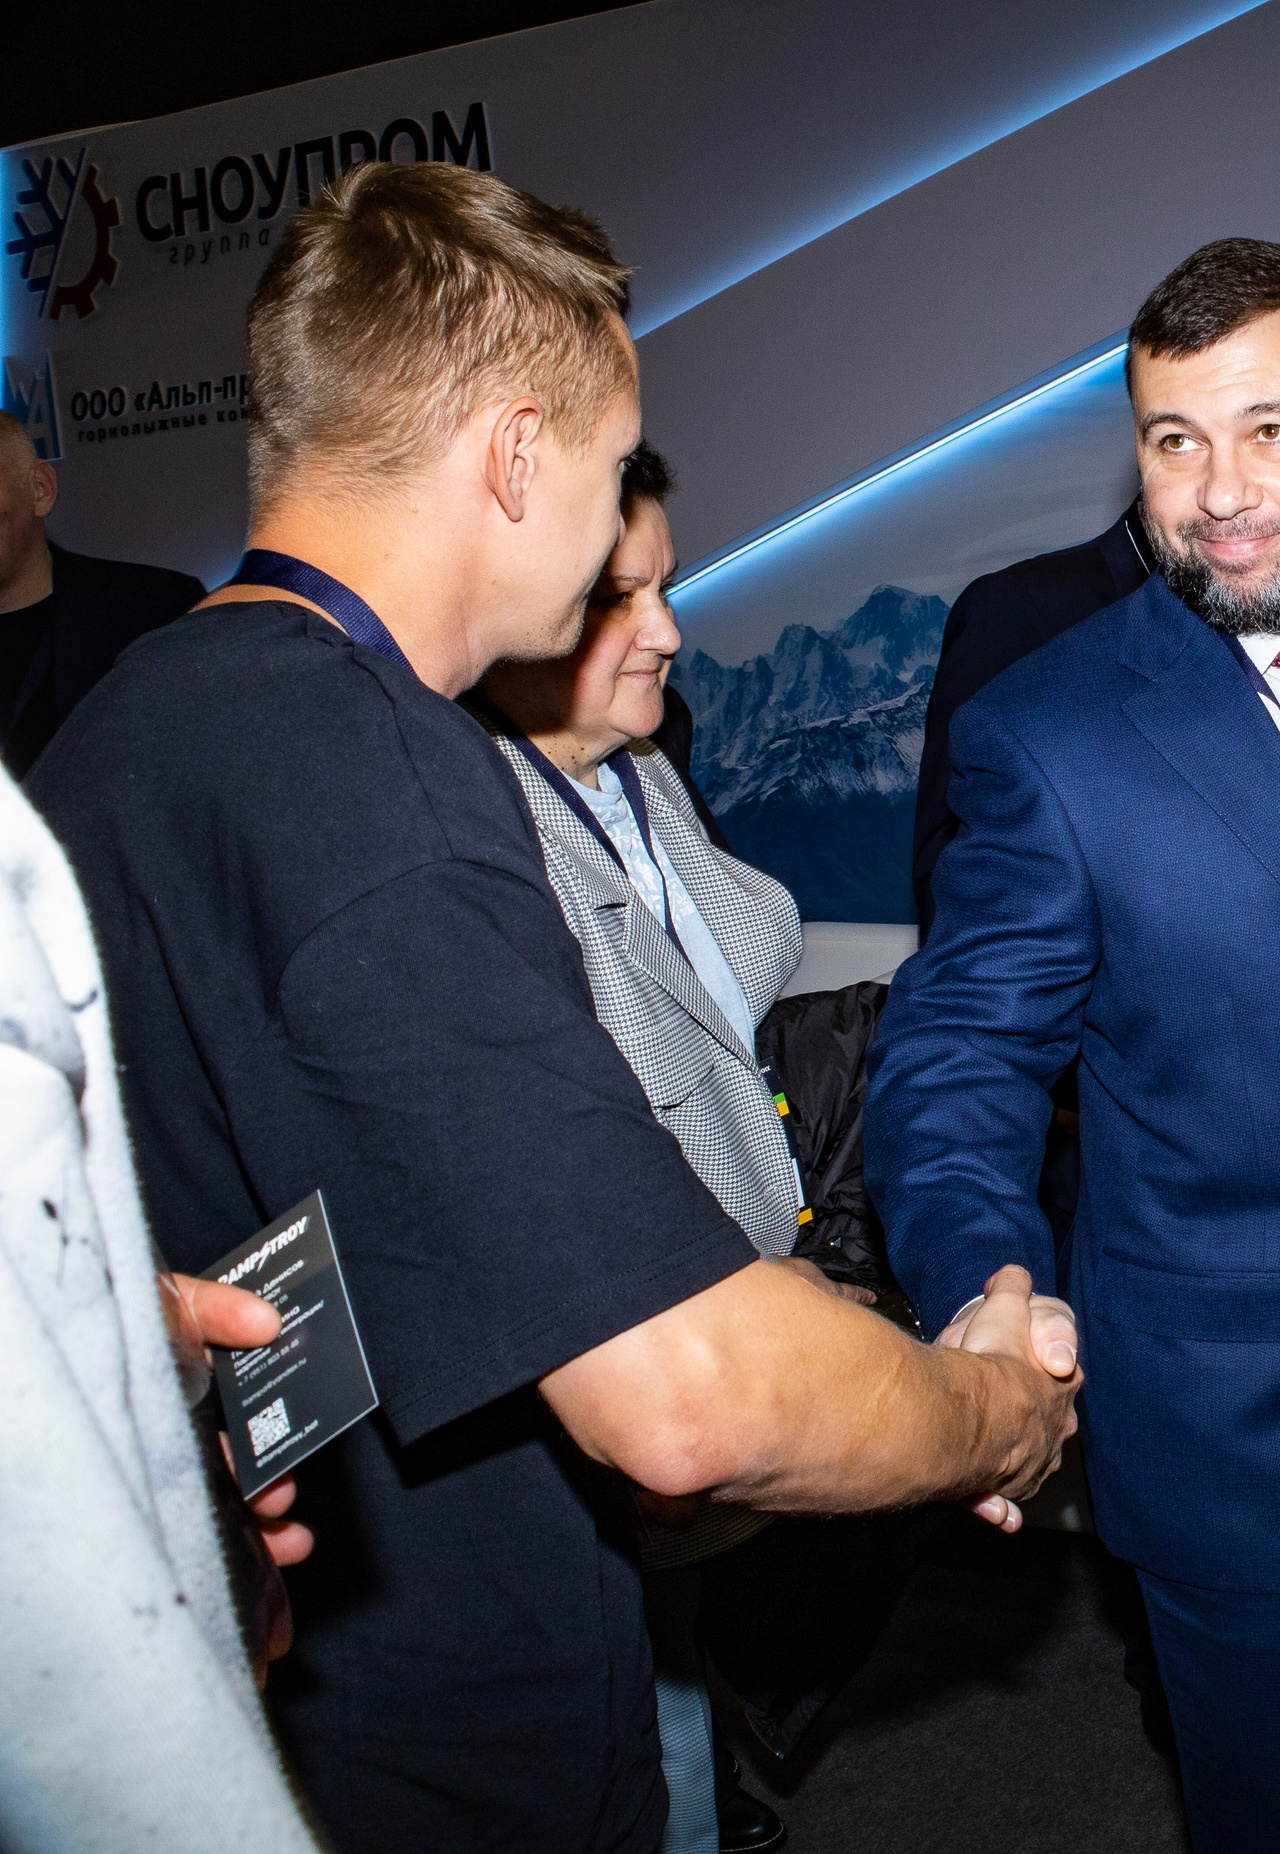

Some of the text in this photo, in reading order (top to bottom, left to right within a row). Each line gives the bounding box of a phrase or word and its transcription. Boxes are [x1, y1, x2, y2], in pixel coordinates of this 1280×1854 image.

[170, 228, 270, 267] группа
[71, 387, 126, 421] ООО
[78, 413, 207, 444] горнолыжные
[263, 1259, 304, 1290] Денисов
